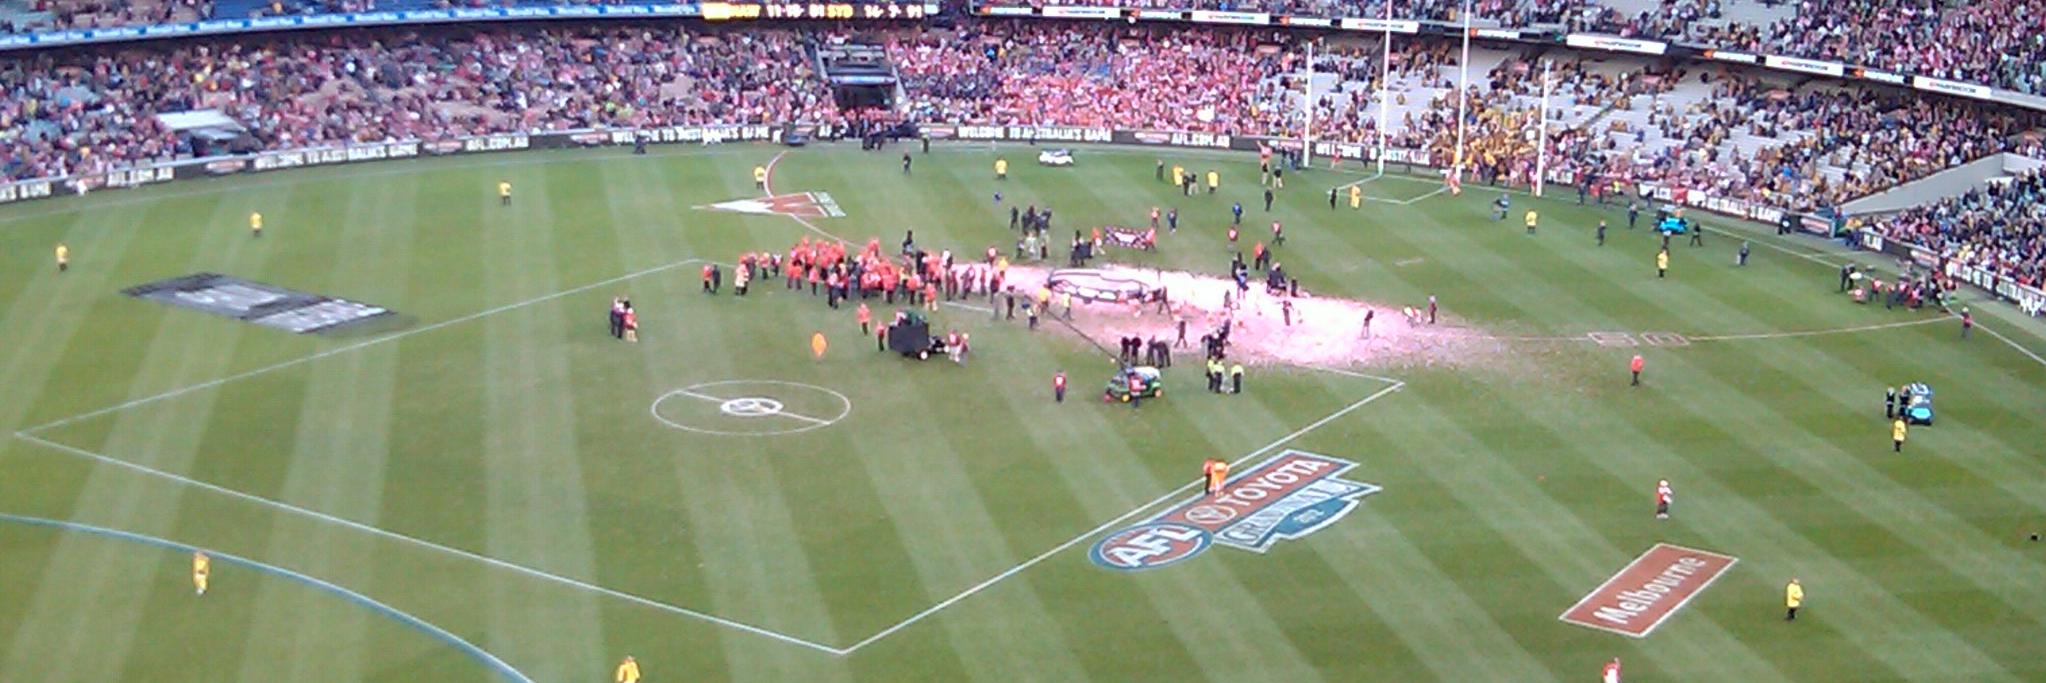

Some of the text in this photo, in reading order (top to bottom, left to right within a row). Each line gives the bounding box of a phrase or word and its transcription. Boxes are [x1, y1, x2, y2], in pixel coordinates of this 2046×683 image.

[1214, 457, 1331, 508] TOYOTA
[1107, 523, 1203, 568] AFL
[1592, 555, 1707, 625] Melbourne
